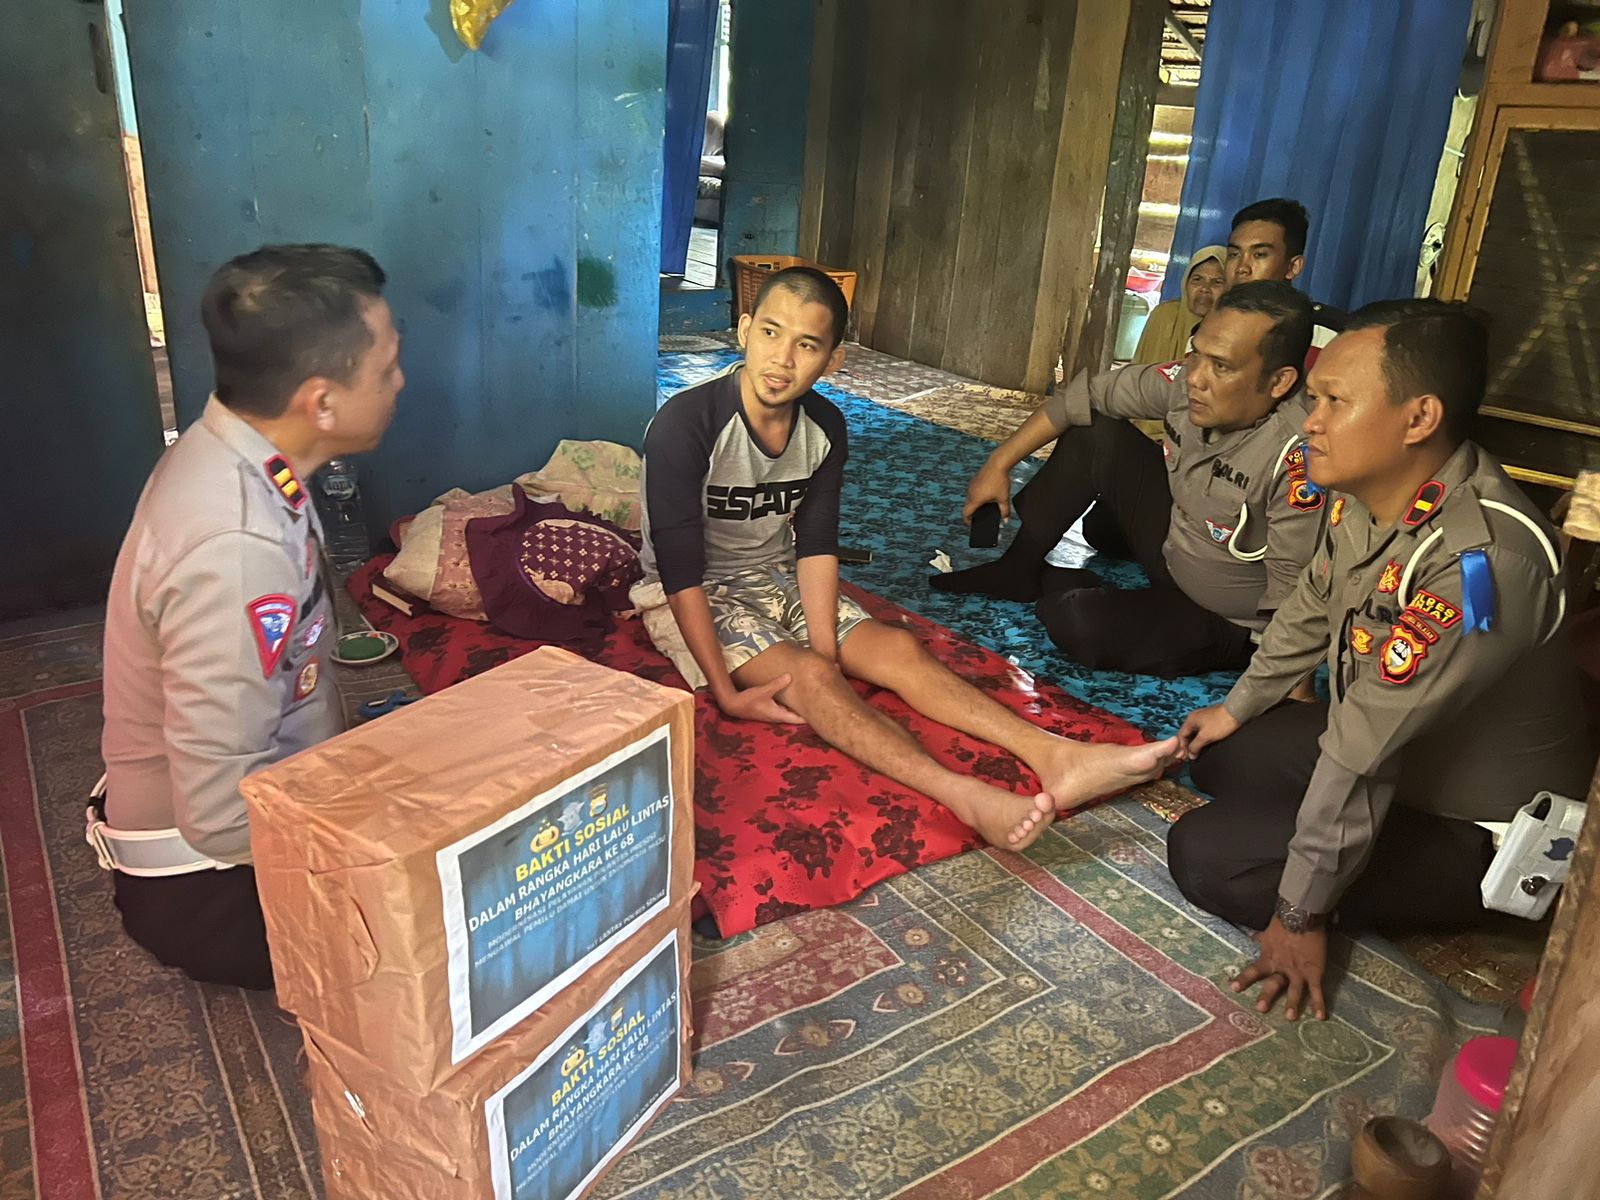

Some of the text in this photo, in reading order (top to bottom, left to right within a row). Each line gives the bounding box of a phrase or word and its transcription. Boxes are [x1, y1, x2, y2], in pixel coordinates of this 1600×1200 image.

[469, 796, 669, 931] DALAM RANGKA HARI LALU LINTAS
[515, 804, 629, 882] BAKTI SOSIAL
[515, 833, 635, 920] BHAYANGKARA KE 68
[510, 1118, 549, 1161] DALAM
[552, 1075, 594, 1121] RANGKA
[597, 1052, 620, 1077] HARI
[622, 1026, 645, 1053] LALU
[647, 992, 676, 1027] LINTAS
[549, 1035, 649, 1140] BHAYANGKARA KE 68
[552, 1011, 645, 1107] BAKTI SOSIAL
